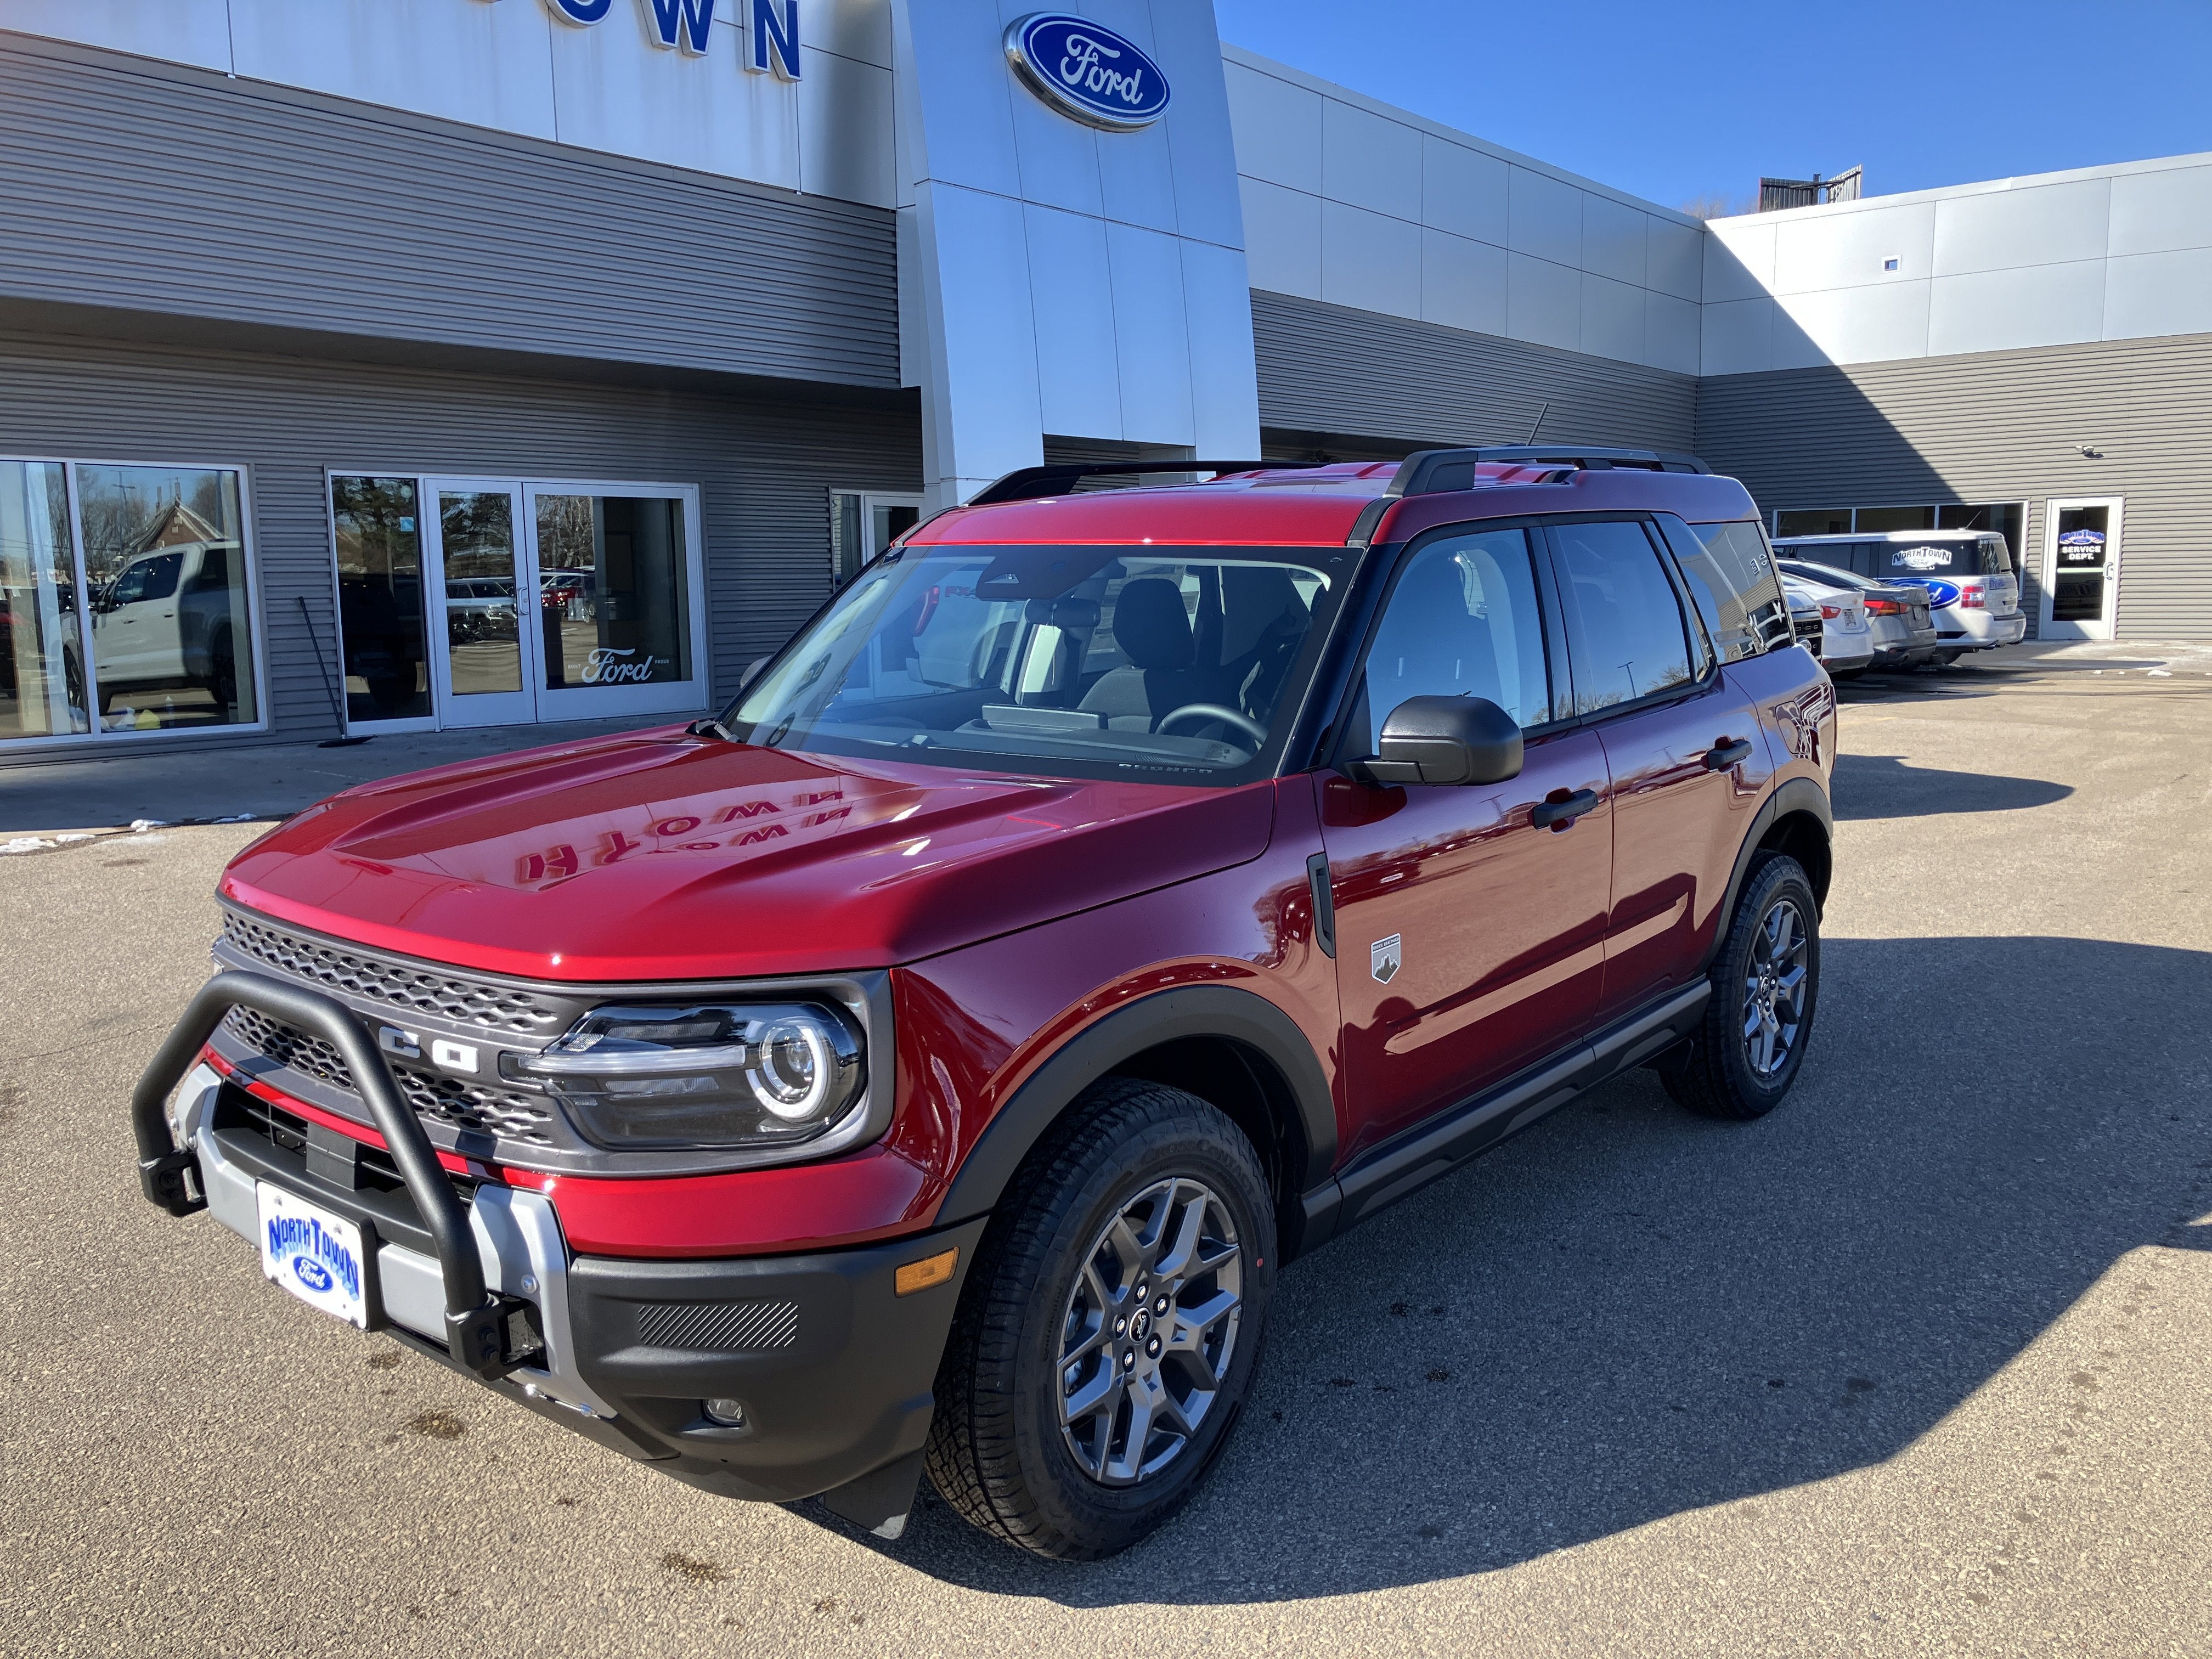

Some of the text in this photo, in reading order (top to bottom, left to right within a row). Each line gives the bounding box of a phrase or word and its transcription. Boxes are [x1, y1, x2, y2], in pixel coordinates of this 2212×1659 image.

[1060, 34, 1143, 104] Ford
[582, 648, 653, 683] Ford
[1384, 938, 1399, 946] BEND
[364, 1020, 480, 1073] CO
[298, 1259, 326, 1289] Ford
